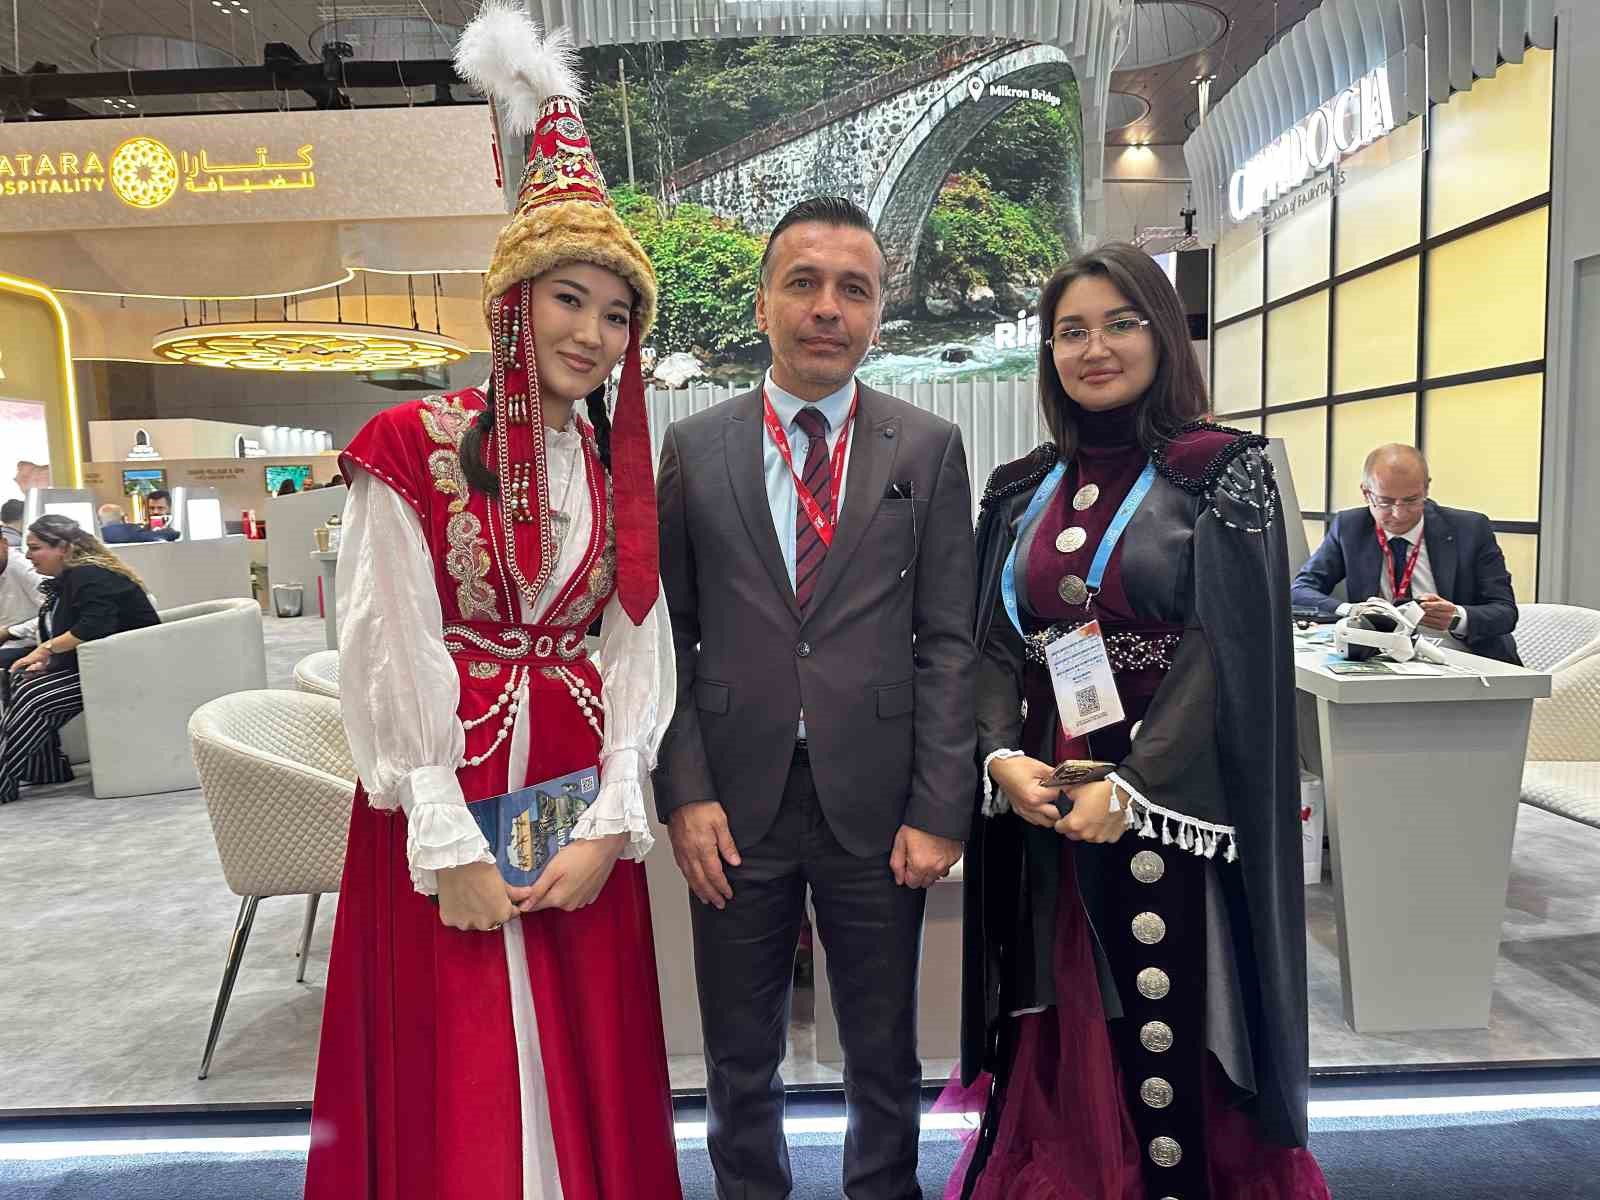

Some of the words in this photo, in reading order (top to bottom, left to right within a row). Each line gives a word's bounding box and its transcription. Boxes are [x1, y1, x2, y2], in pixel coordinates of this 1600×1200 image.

[990, 85, 1029, 98] Mikron
[1031, 88, 1061, 107] Bridge
[181, 144, 313, 177] كتارا
[1297, 170, 1346, 208] FAIRYTAES
